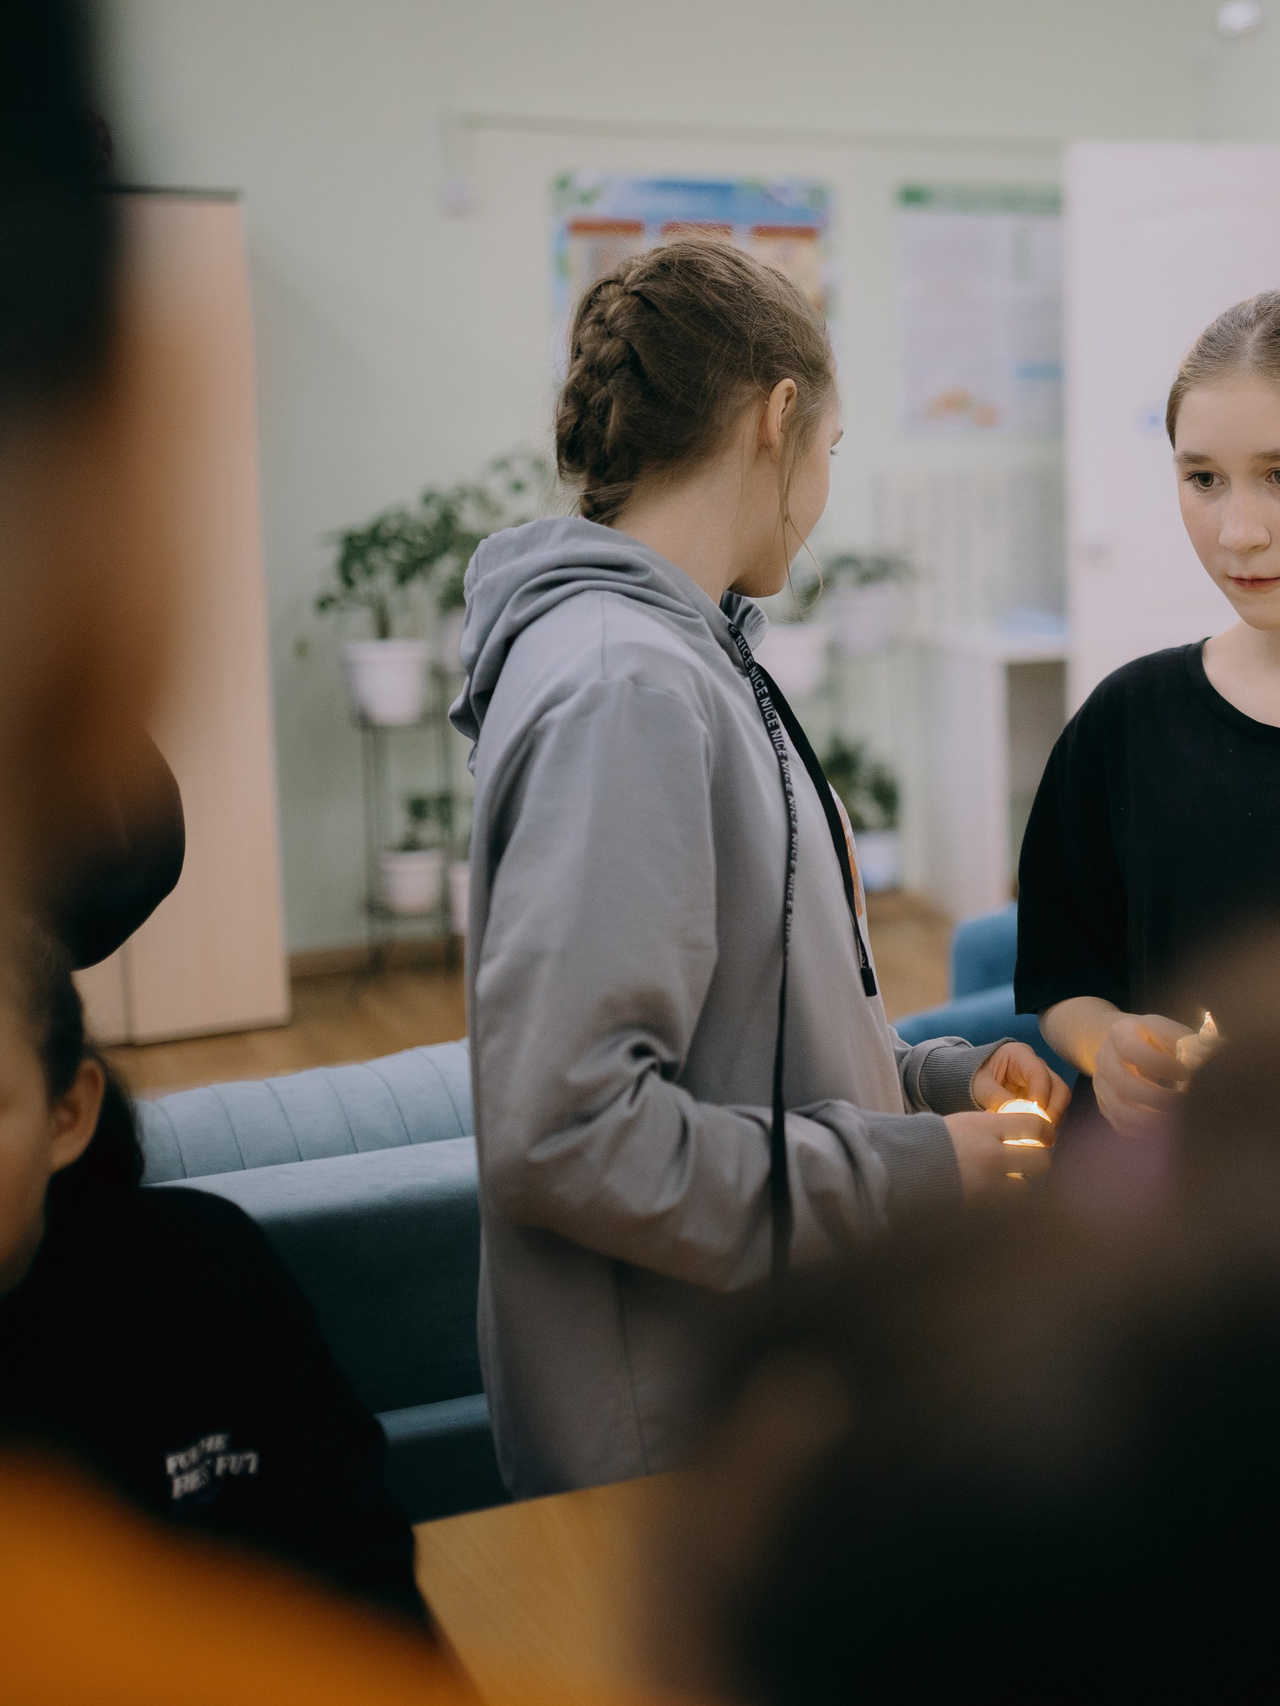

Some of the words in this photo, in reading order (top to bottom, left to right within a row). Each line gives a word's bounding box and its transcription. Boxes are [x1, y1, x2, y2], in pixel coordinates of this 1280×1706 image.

[736, 635, 754, 668] NICE
[748, 667, 769, 697] NICE
[760, 697, 779, 728] NICE
[770, 729, 787, 757] NICE
[781, 759, 793, 792] NICE
[788, 795, 798, 829] NICE
